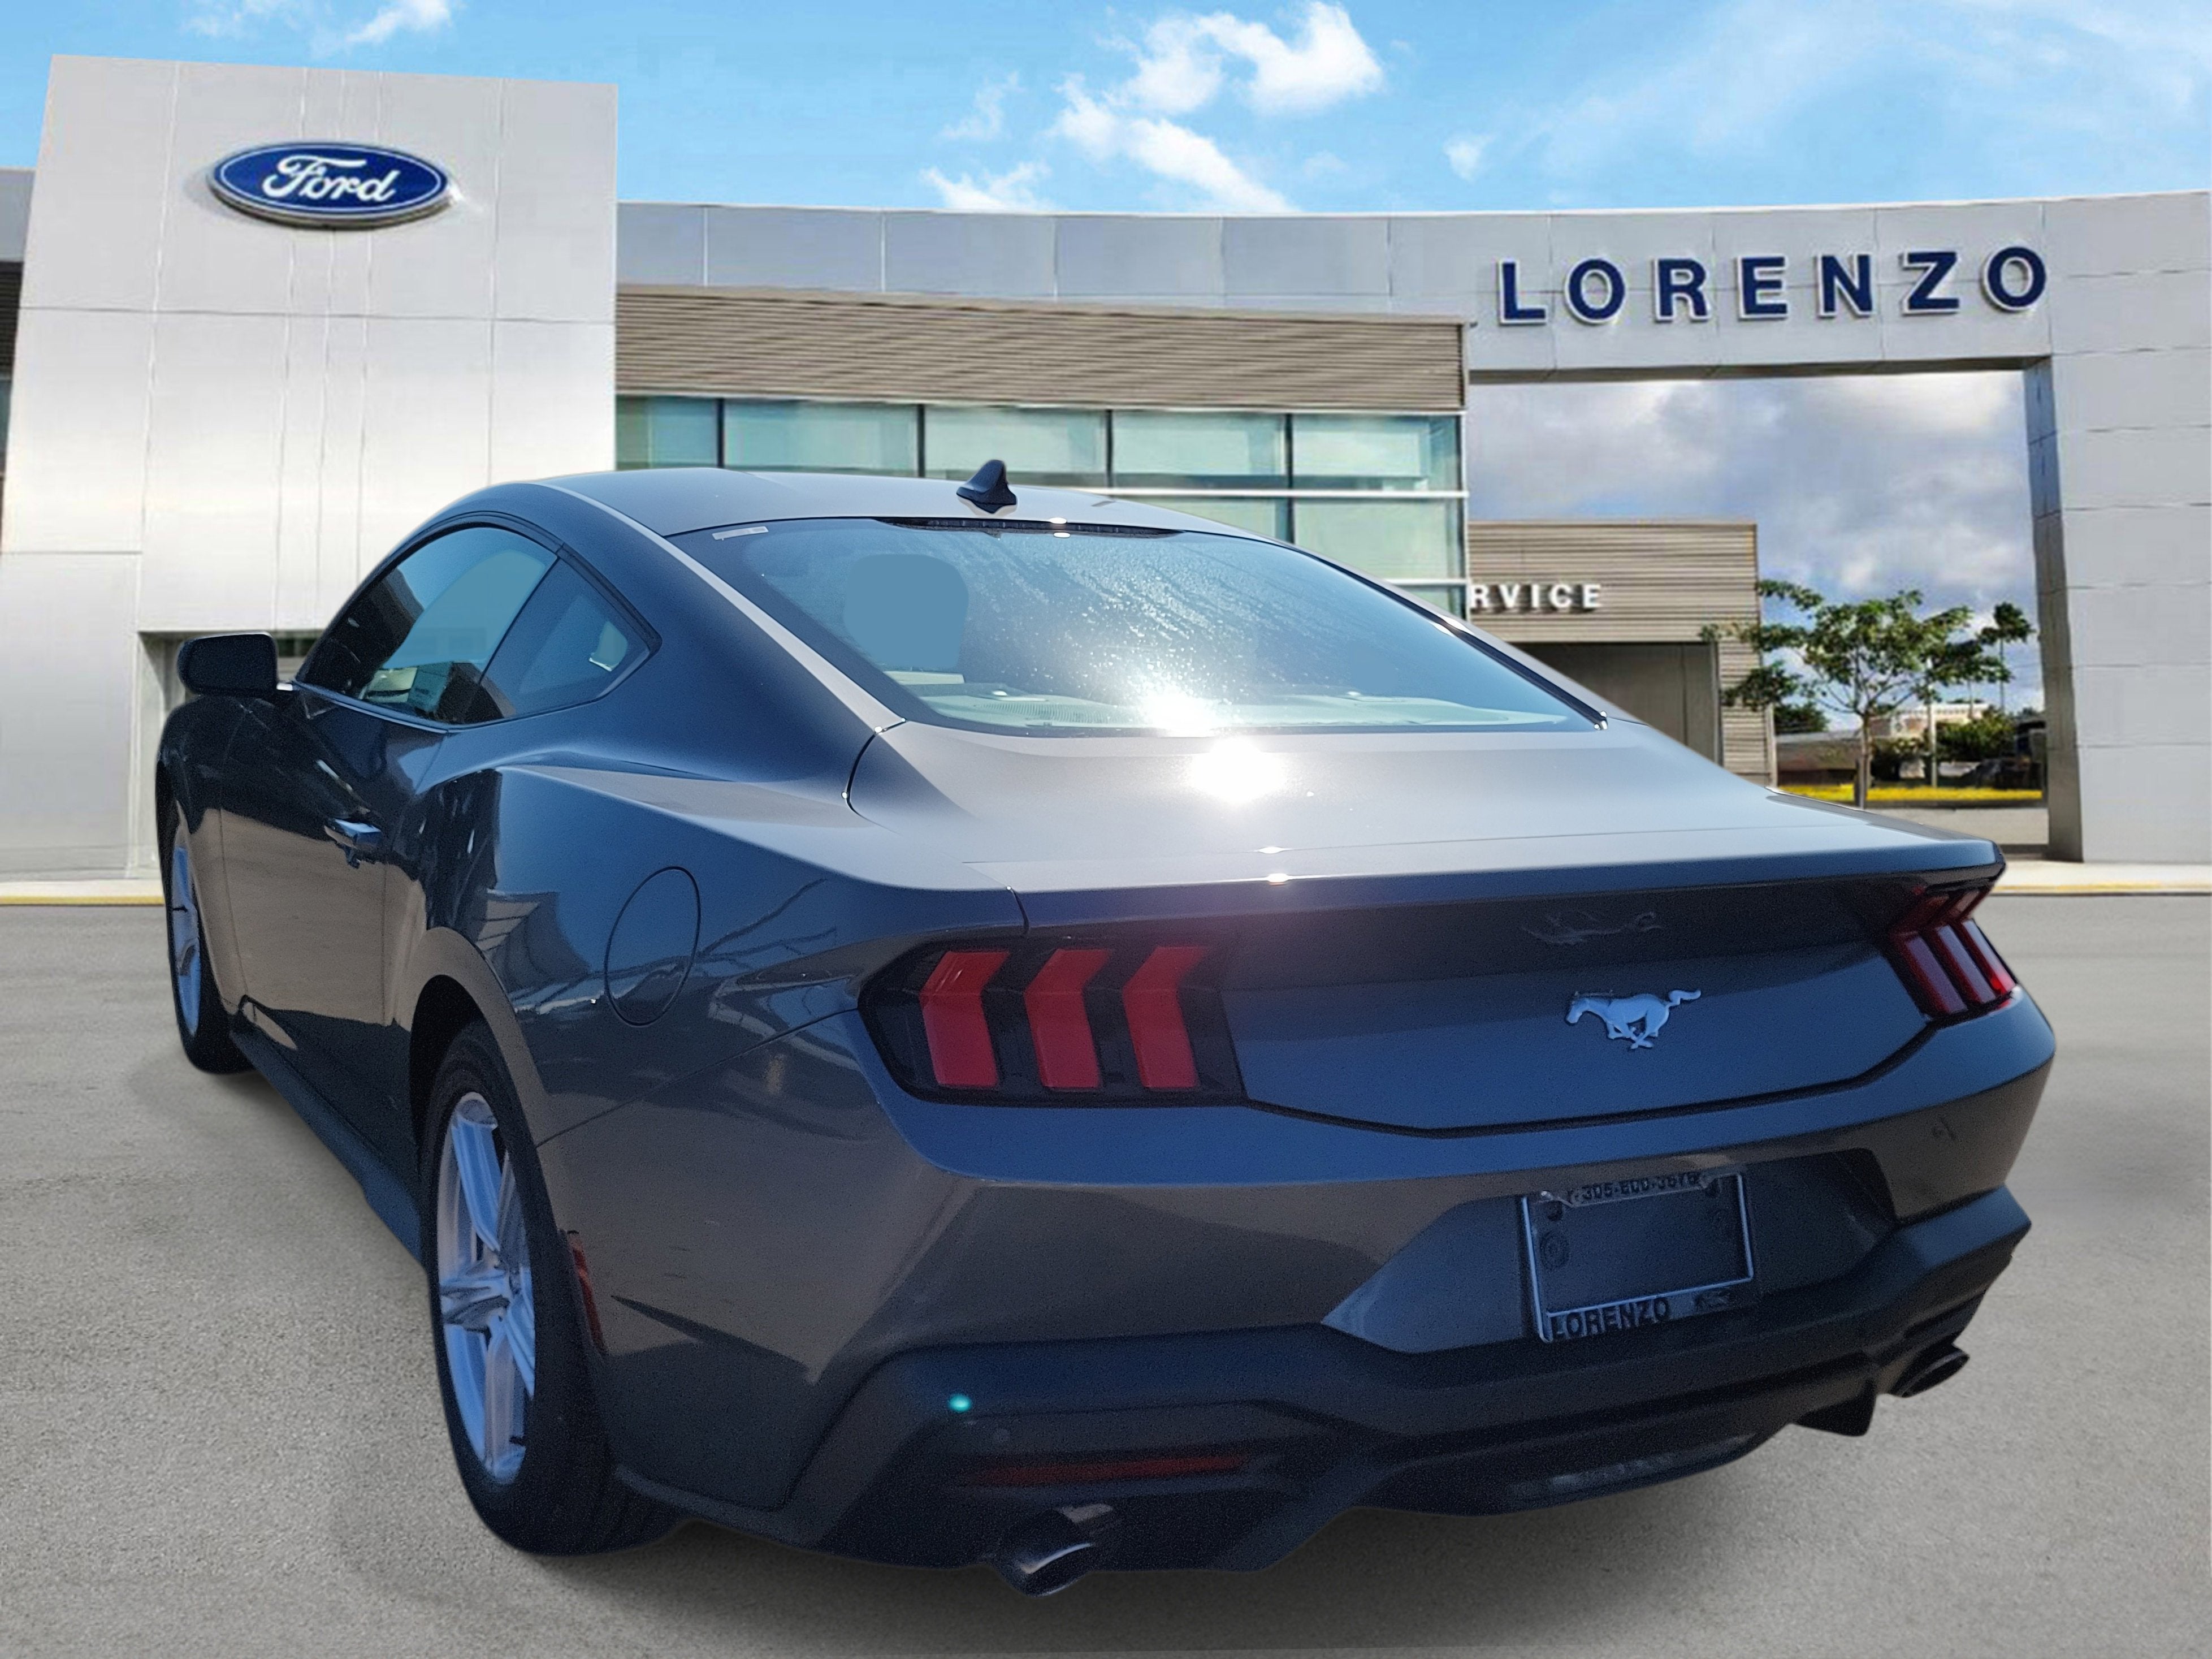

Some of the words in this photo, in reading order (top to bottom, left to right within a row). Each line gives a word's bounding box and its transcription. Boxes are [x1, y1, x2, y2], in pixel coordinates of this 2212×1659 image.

[262, 154, 401, 201] Ford
[1499, 245, 2046, 323] LORENZO
[1551, 1297, 1669, 1338] LORENZO
